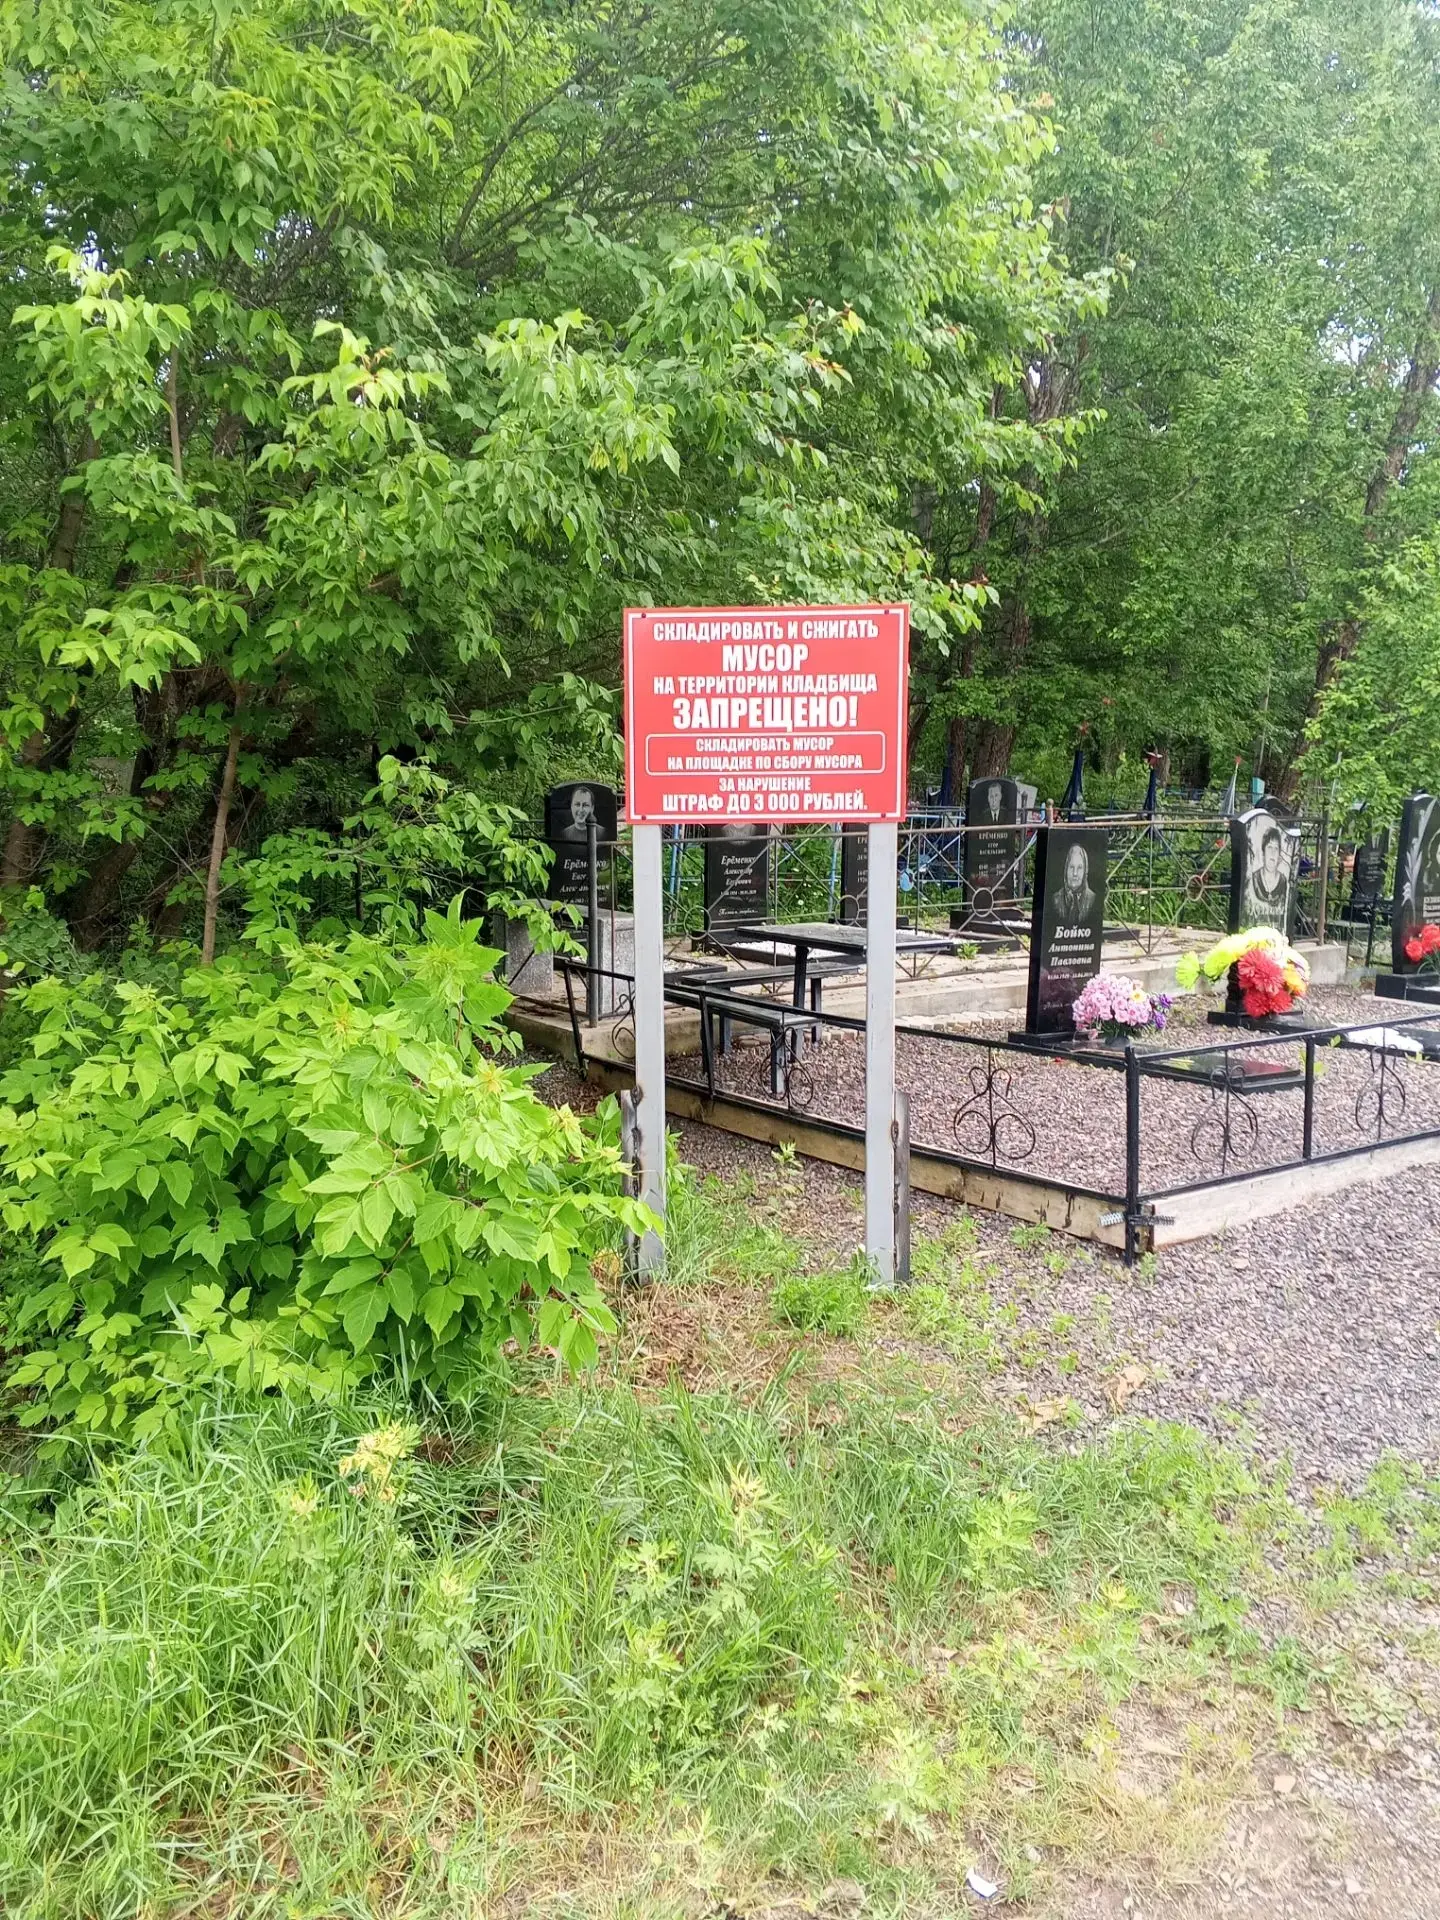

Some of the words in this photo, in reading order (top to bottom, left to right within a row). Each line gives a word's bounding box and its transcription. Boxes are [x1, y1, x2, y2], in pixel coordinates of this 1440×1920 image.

[653, 621, 783, 643] СКЛАДИРОВАТЬ
[787, 621, 798, 639] И
[802, 620, 879, 639] СЖИГАТЬ
[722, 644, 809, 672] МУСОР
[653, 677, 675, 695] НА
[678, 675, 778, 694] ТЕРРИТОРИИ
[782, 674, 878, 695] КЛАДБИЩА
[673, 695, 858, 732] ЗАПРЕЩЕНО!
[696, 738, 791, 753] СКЛАДИРОВАТЬ
[793, 737, 834, 751] МУСОР
[667, 757, 683, 770] НА
[685, 756, 753, 772] ПЛОЩАДКЕ
[756, 756, 771, 769] ПО
[774, 755, 812, 769] СБОРУ
[814, 755, 863, 769] МУСОРА
[719, 778, 735, 792] ЗА
[737, 777, 811, 791] НАРУШЕНИЕ
[663, 794, 724, 812] ШТРАФ
[727, 795, 751, 813] ДО
[754, 795, 764, 811] 3
[768, 794, 799, 811] 000
[803, 790, 868, 811] РУБЛЕЙ.
[564, 859, 607, 870] Ерёмко
[1054, 925, 1091, 939] Бойко
[1048, 943, 1095, 953] Антонина
[1050, 956, 1092, 967] Павловна
